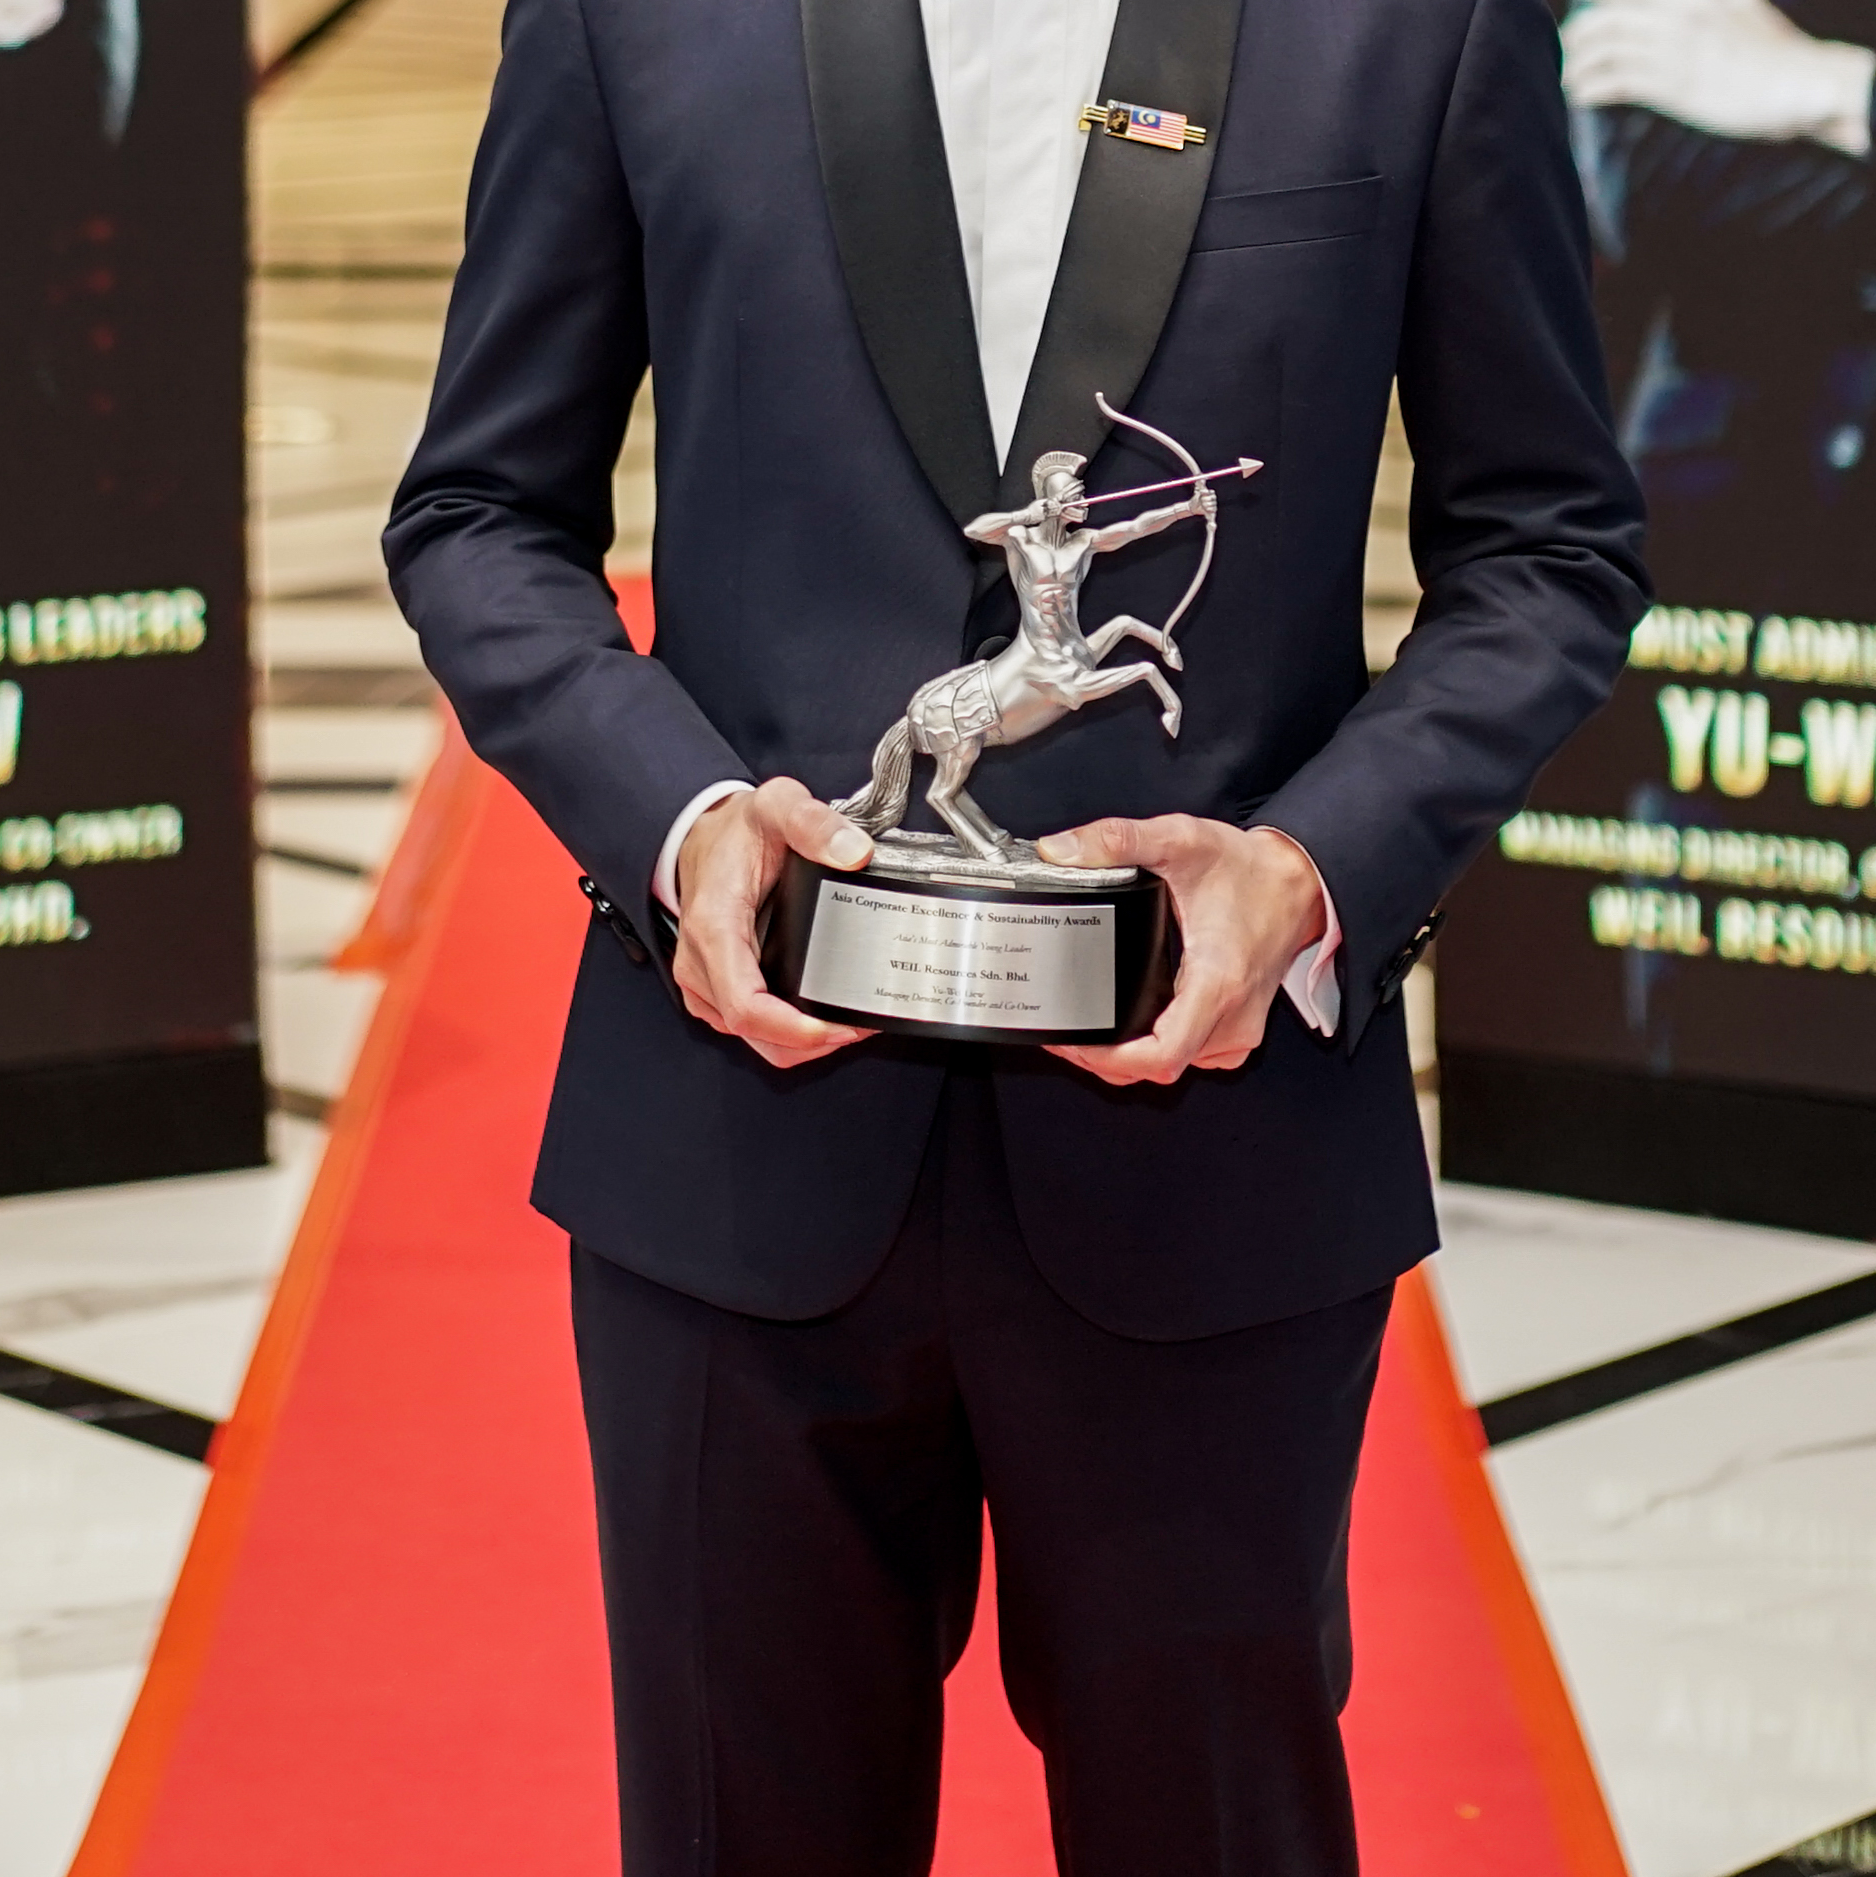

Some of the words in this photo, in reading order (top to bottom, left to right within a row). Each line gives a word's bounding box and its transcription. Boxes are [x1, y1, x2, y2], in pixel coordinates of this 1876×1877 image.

[8, 588, 207, 665] LEADERS
[1627, 604, 1754, 675] MOST
[831, 891, 853, 904] Asia
[855, 895, 909, 917] Corporate
[911, 904, 970, 921] Excellence
[974, 911, 984, 922] &
[987, 912, 1062, 929] Sustainability
[1063, 915, 1102, 926] Awards
[1589, 885, 1711, 957] WEIL
[889, 959, 921, 973] WEIL
[979, 969, 1003, 982] Sdn.
[1006, 971, 1031, 982] Bhd.
